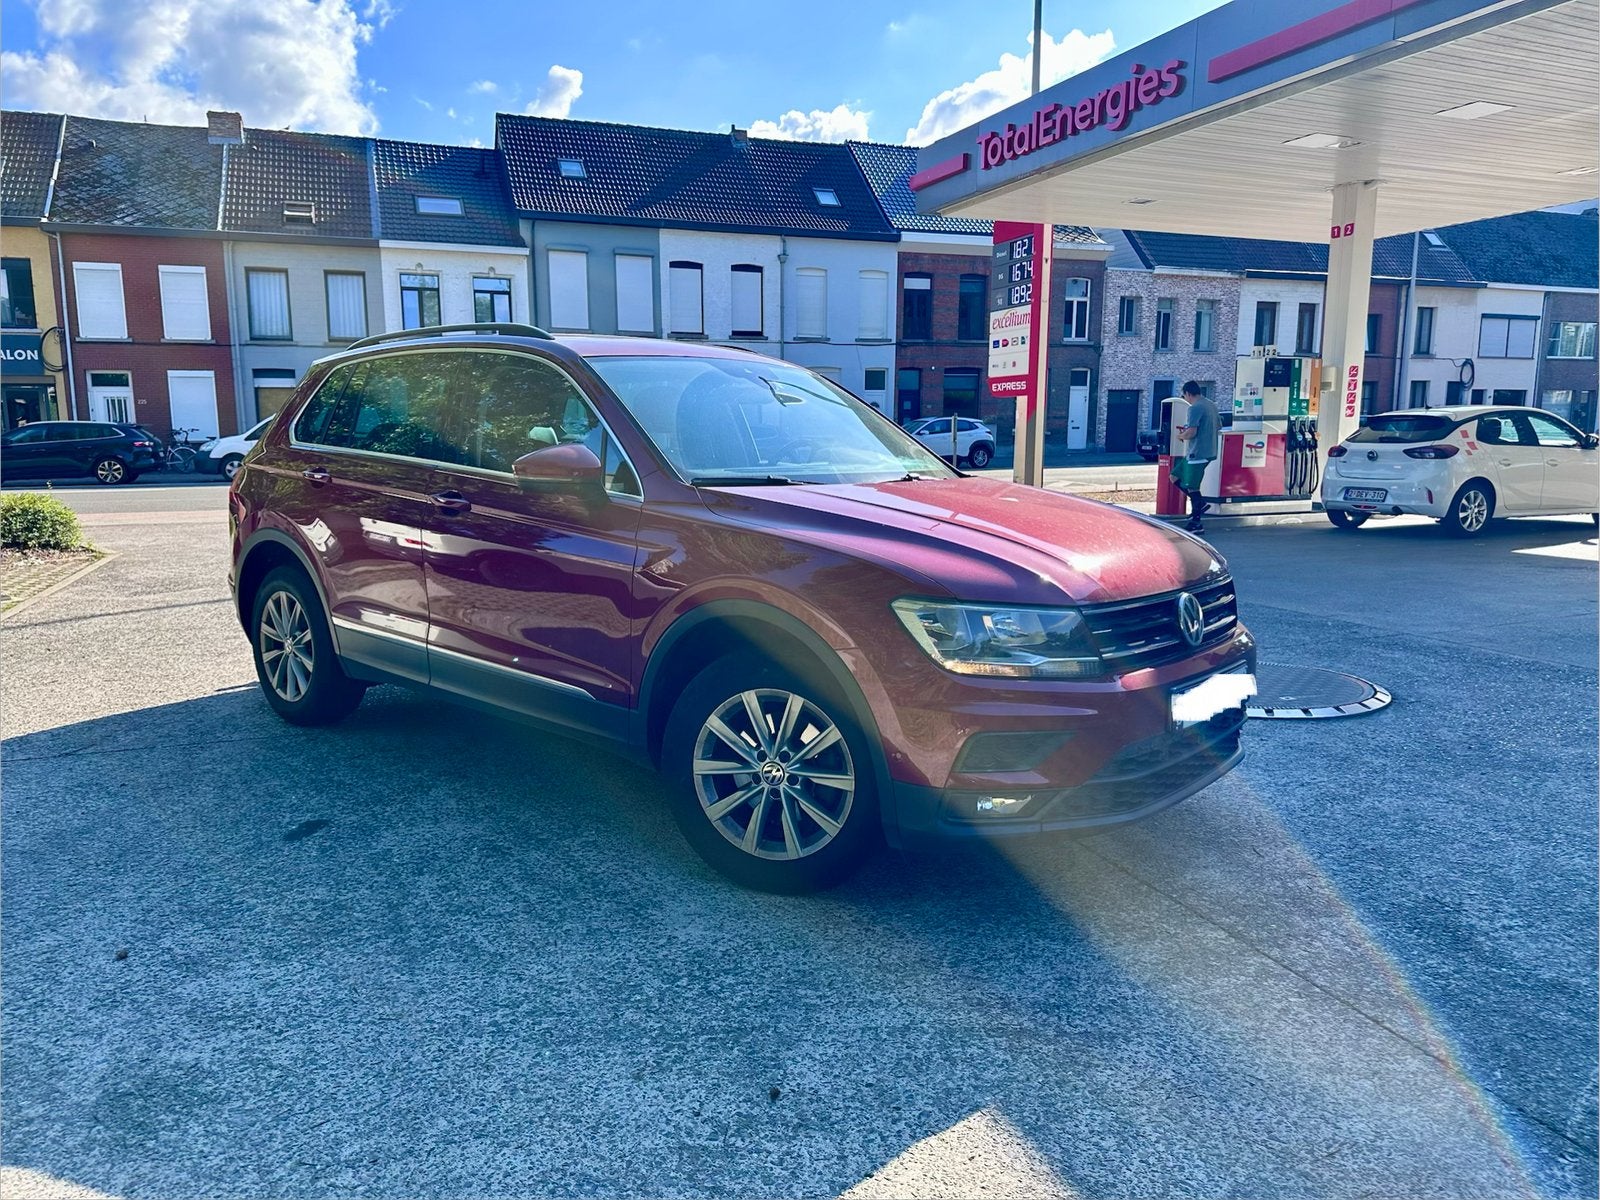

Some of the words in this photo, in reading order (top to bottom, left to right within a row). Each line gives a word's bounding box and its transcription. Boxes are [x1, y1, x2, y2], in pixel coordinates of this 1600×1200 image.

[976, 59, 1187, 170] TotalEnergies
[1346, 224, 1352, 235] 2
[992, 311, 1031, 330] excellium
[991, 380, 1027, 392] EXPRESS
